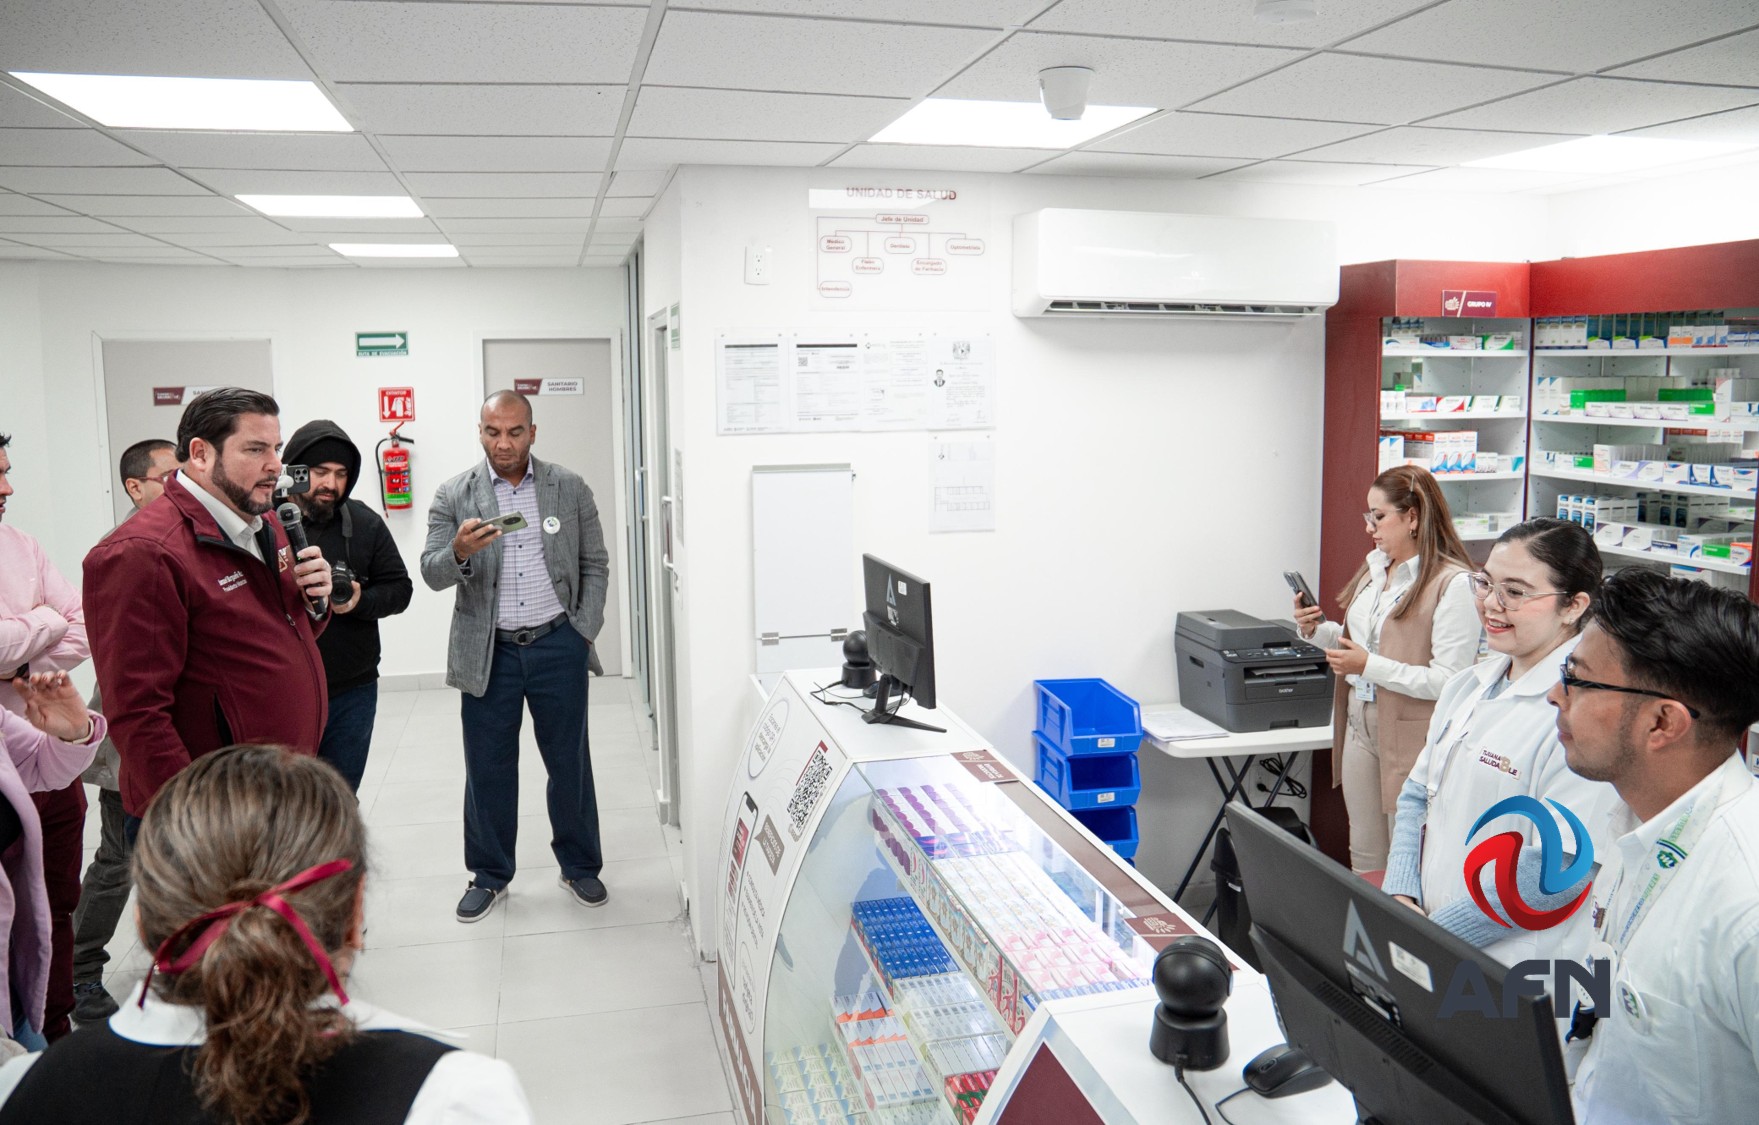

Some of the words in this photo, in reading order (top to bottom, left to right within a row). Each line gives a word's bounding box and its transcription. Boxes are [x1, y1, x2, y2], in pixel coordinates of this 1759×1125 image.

[846, 187, 893, 199] UNIDAD
[897, 188, 913, 199] DE
[916, 188, 957, 200] SALUD
[1479, 756, 1518, 776] SALUDABLE
